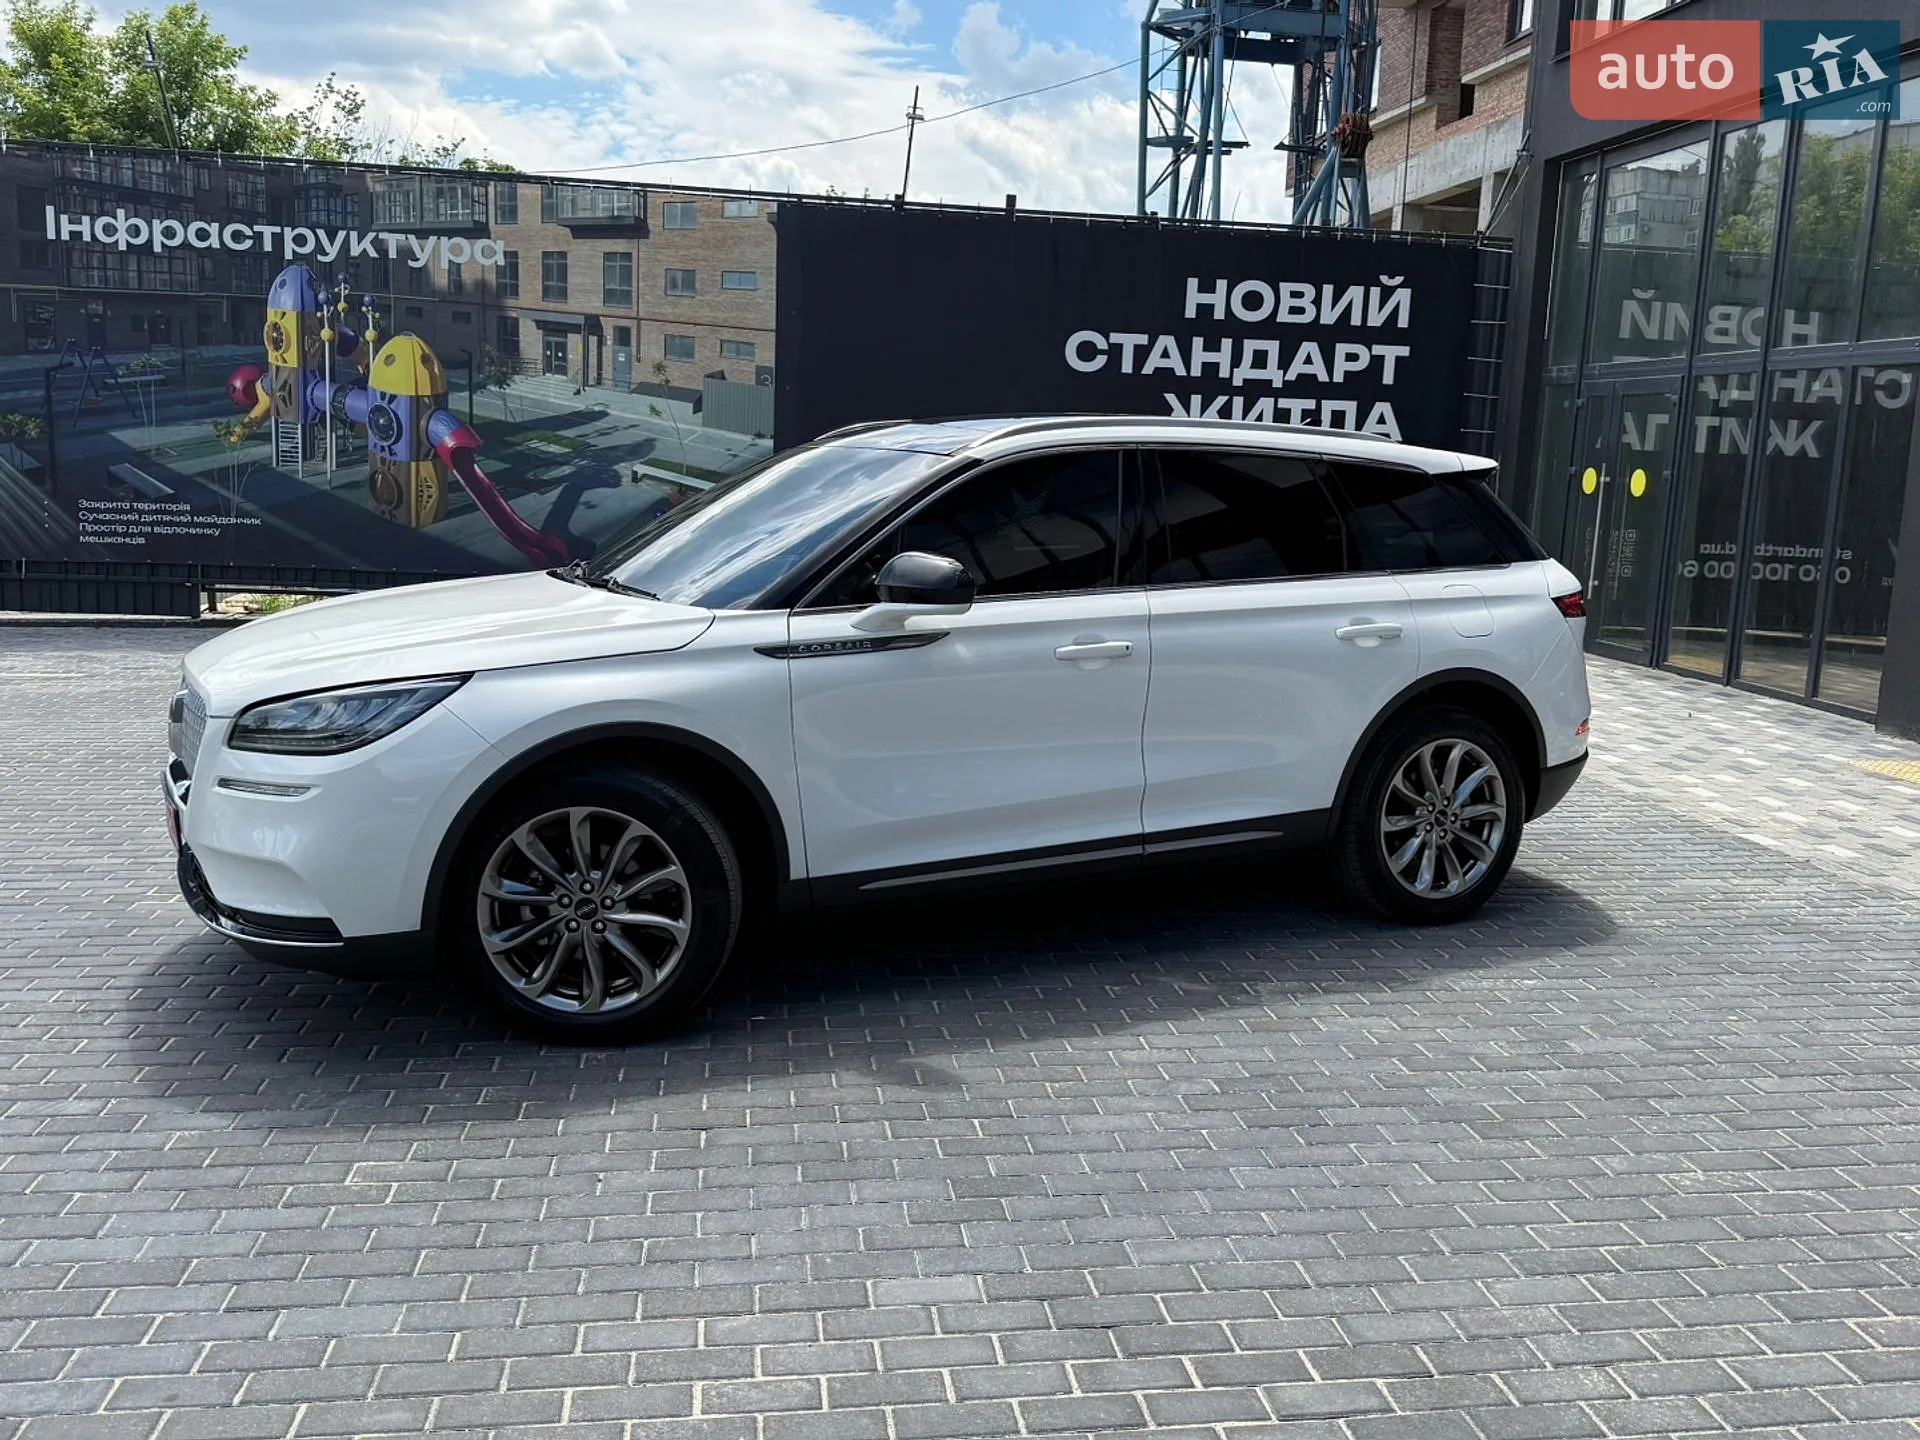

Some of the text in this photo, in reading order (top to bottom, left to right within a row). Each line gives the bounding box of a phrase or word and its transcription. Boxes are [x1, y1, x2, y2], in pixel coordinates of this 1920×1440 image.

[45, 204, 506, 269] Інфраструктура
[1184, 275, 1412, 328] НОВИЙ
[1064, 330, 1411, 388] СТАНДАРТ
[1163, 393, 1403, 442] ЖИТЛА
[78, 498, 191, 511] Закрита територія
[78, 511, 262, 525] Сучасний дитячий майданчик
[79, 522, 222, 536] Простір для відпочинку
[79, 535, 146, 545] мешканців
[798, 640, 873, 653] CORSAIR
